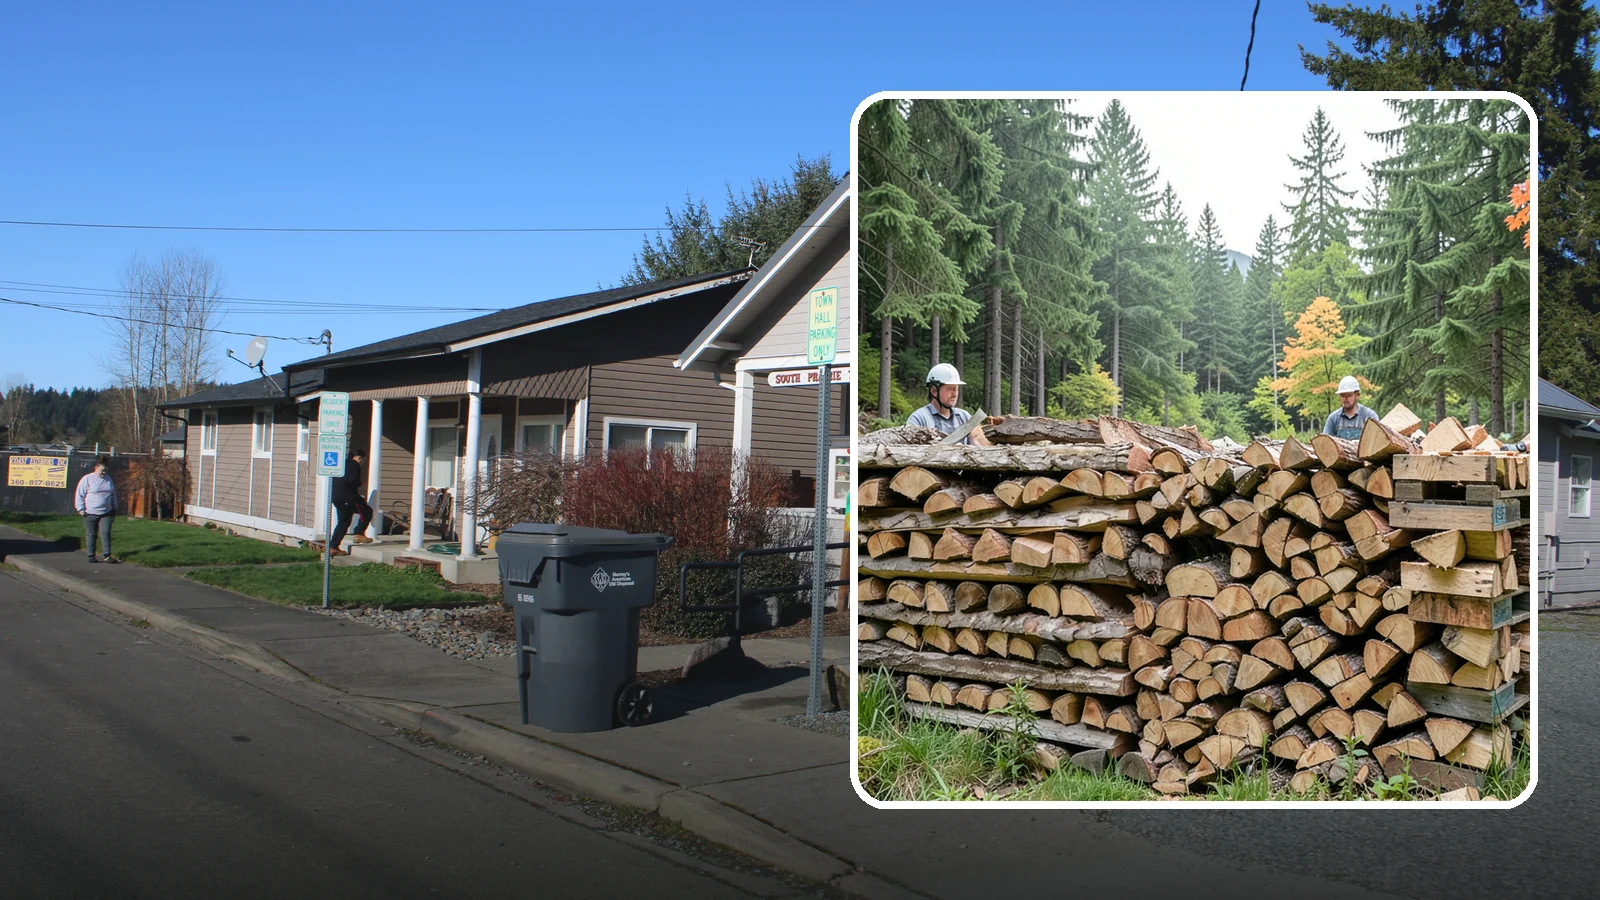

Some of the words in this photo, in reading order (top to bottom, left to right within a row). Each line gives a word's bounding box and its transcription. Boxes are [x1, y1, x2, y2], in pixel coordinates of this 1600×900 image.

[815, 295, 833, 308] TOWN
[815, 311, 831, 324] HALL
[810, 326, 835, 340] PARKING
[814, 344, 831, 357] ONLY
[775, 373, 801, 384] SOUTH
[808, 370, 842, 382] PRIE
